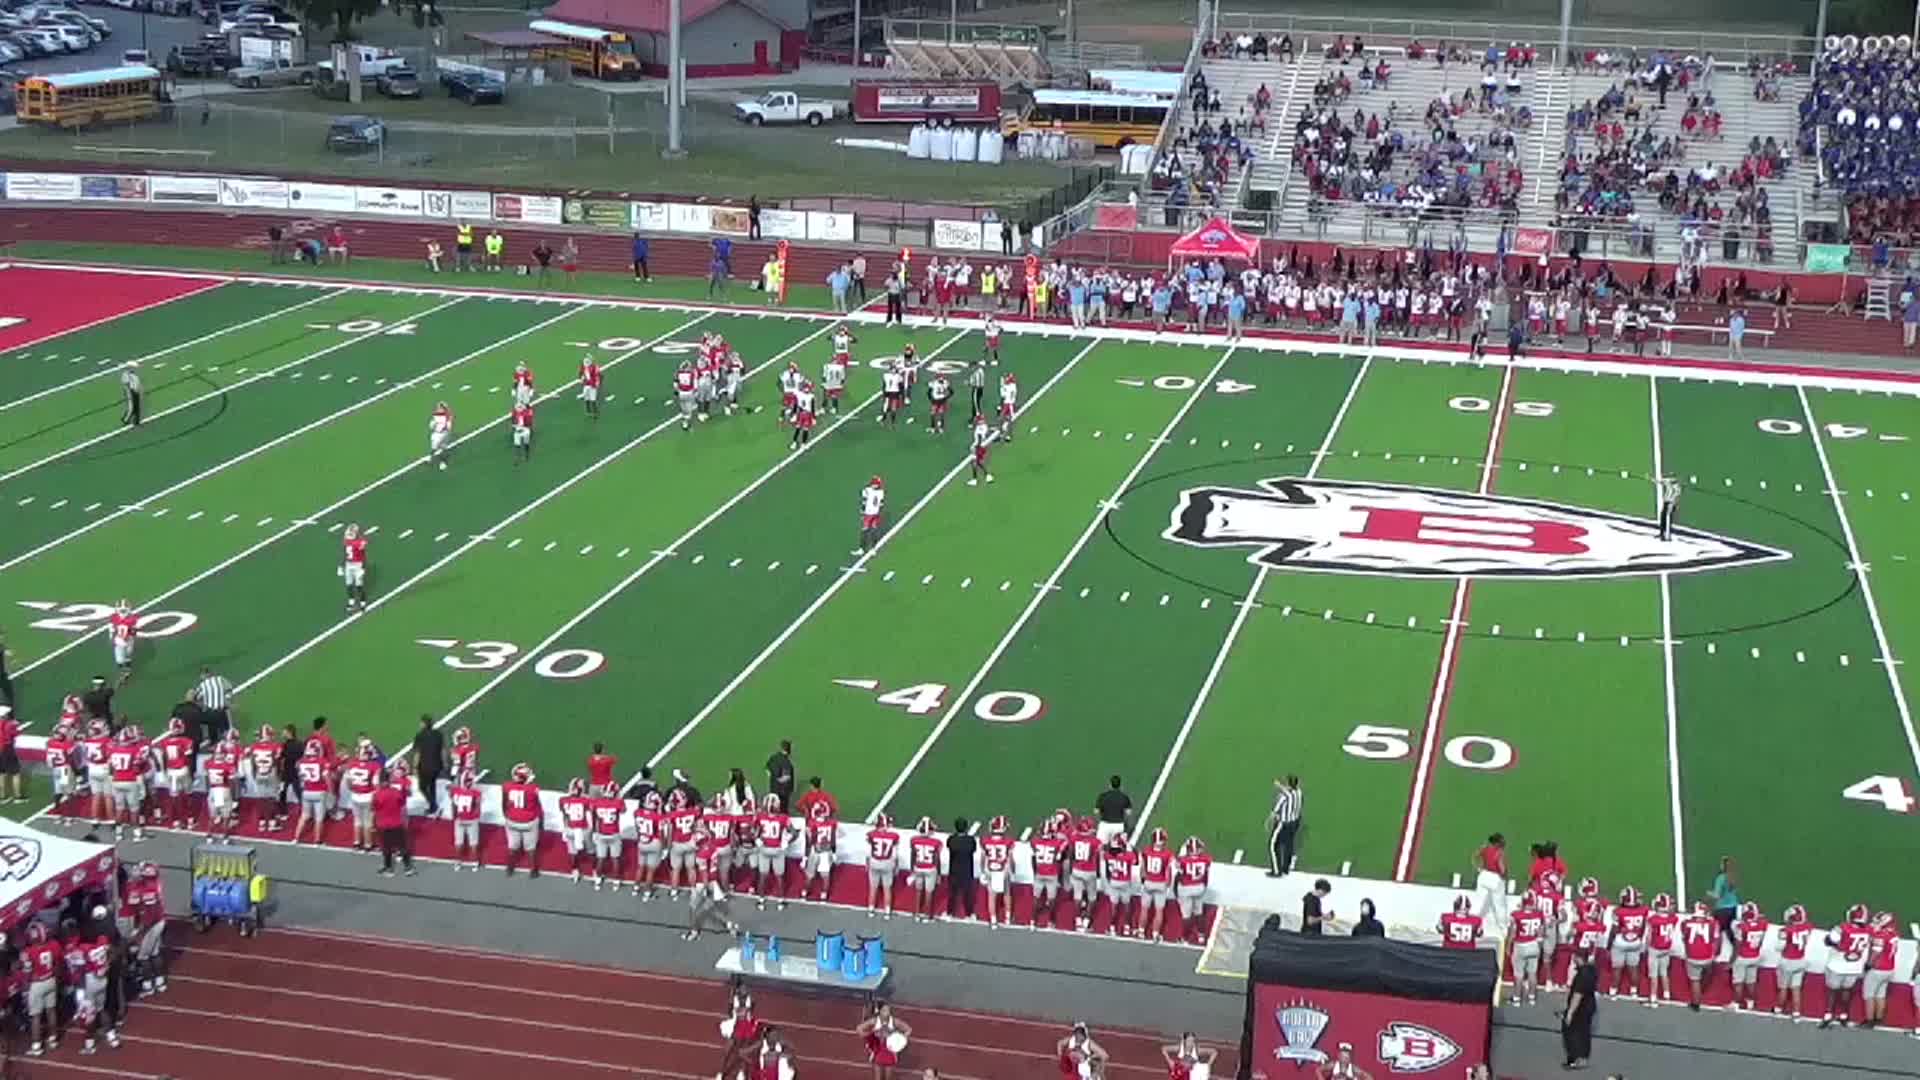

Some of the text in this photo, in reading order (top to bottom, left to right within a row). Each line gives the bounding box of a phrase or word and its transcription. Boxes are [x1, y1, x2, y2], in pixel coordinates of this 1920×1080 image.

[1153, 376, 1256, 393] 40
[1449, 396, 1554, 417] 50
[1758, 419, 1868, 438] 40
[1341, 505, 1590, 555] B
[442, 640, 605, 679] 30
[875, 682, 1044, 723] 40
[1342, 724, 1514, 770] 50
[760, 819, 780, 839] 30
[872, 838, 893, 858] 37
[985, 844, 1007, 862] 33
[1449, 923, 1473, 943] 58
[1685, 922, 1710, 945] 74
[1404, 1038, 1436, 1058] B
